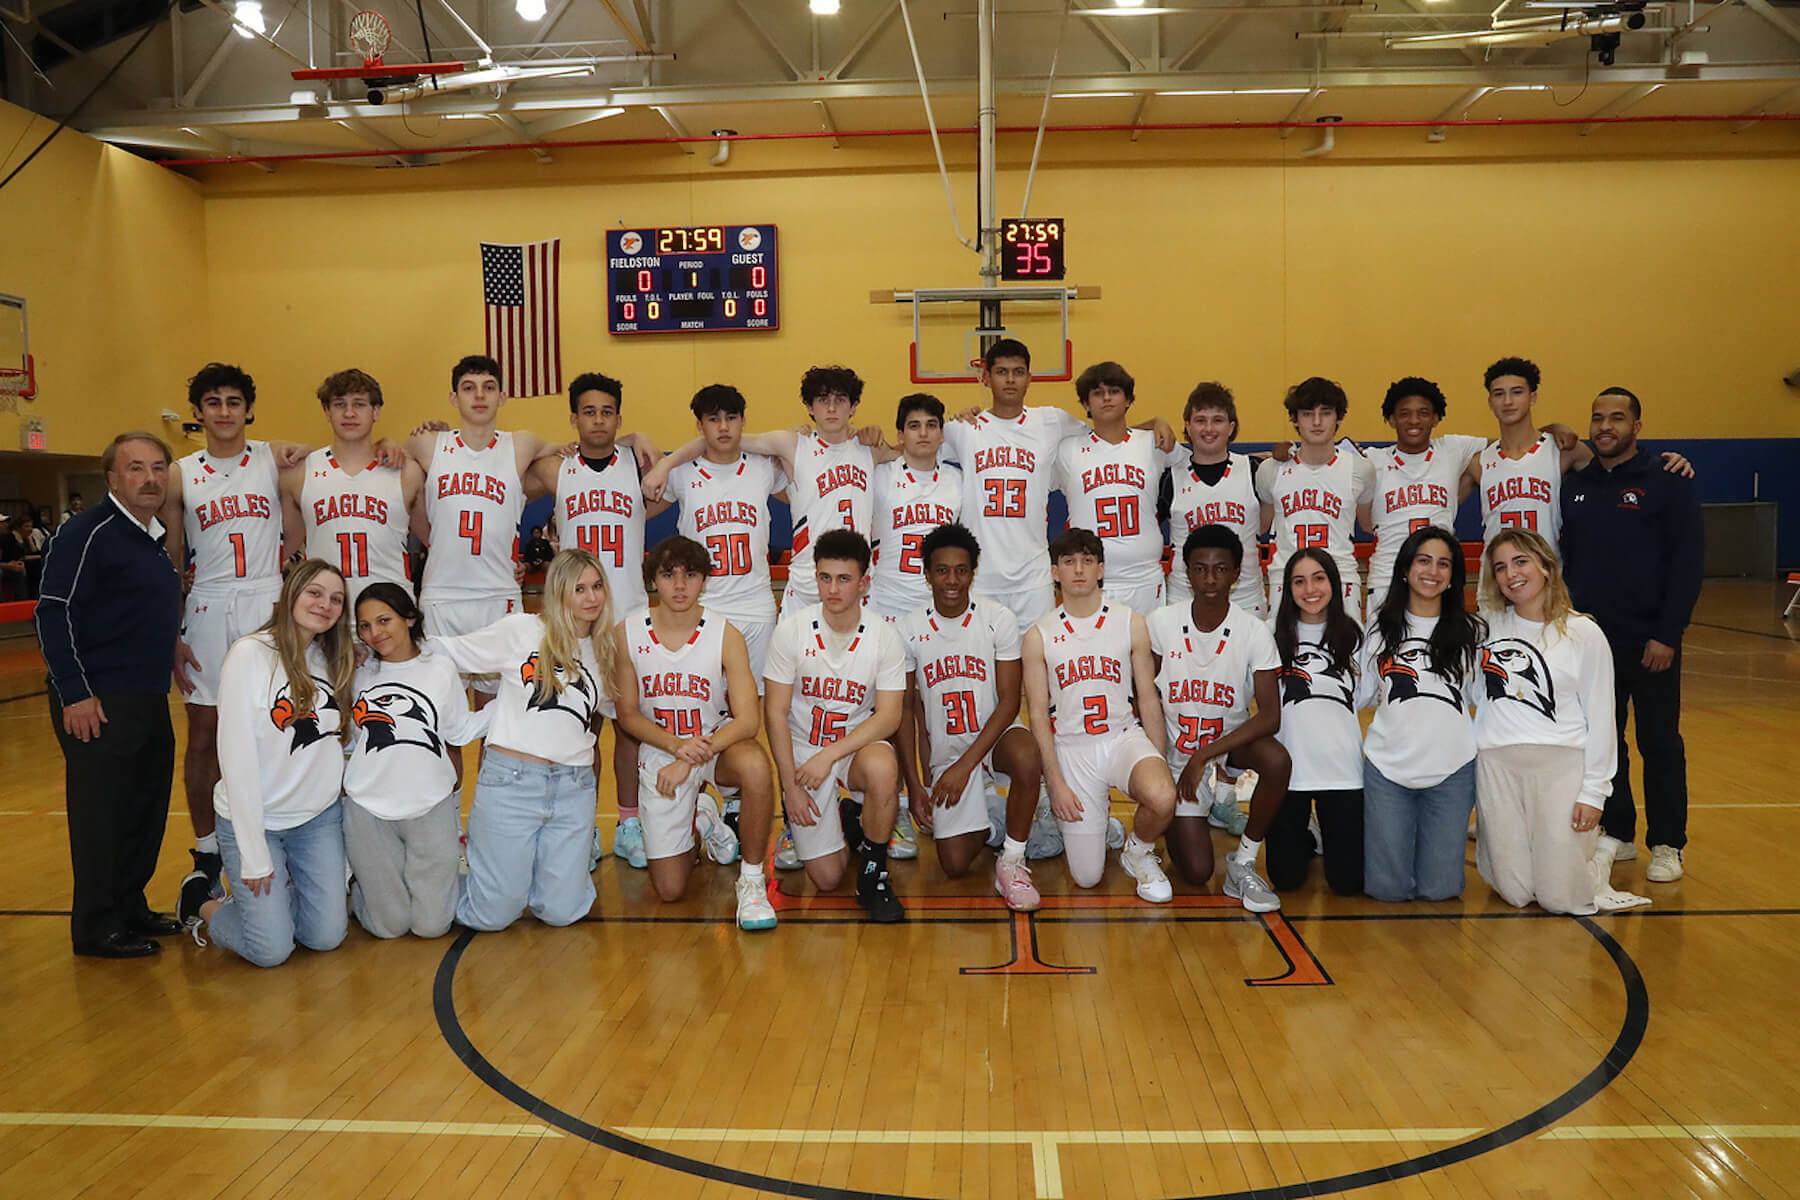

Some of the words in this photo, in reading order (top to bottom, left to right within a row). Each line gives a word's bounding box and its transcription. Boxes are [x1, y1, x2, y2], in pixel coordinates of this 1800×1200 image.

[659, 228, 721, 252] 27:59
[1006, 223, 1059, 242] 27:59
[610, 256, 661, 269] FIELDSTON
[679, 260, 704, 269] PERIOD
[731, 253, 765, 265] GUEST
[1016, 242, 1052, 274] 35
[638, 270, 652, 293] 0
[691, 271, 698, 288] 1
[751, 266, 766, 289] 0
[615, 294, 637, 303] FOULS
[669, 292, 694, 301] PLAYER
[697, 292, 715, 300] FOUL
[724, 299, 736, 318] 0
[746, 290, 769, 299] FOULS
[754, 298, 766, 317] 0
[623, 302, 636, 320] 0
[648, 301, 660, 320] 0
[681, 321, 704, 329] MATCH
[746, 318, 769, 327] SCORE
[616, 322, 638, 331] SCORE
[975, 447, 1036, 474] EAGLES
[438, 473, 506, 505] EAGLES
[816, 464, 868, 498] EAGLES
[1081, 464, 1145, 494] EAGLES
[1487, 477, 1551, 511] EAGLES
[195, 494, 270, 531] EAGLES
[313, 494, 388, 526] EAGLES
[565, 489, 633, 520] EAGLES
[984, 479, 1027, 518] 33
[1280, 489, 1342, 519] EAGLES
[1385, 484, 1448, 514] EAGLES
[694, 501, 757, 533] EAGLES
[838, 499, 855, 531] 3
[893, 504, 954, 530] EAGLES
[1095, 495, 1140, 538] 50
[1185, 502, 1246, 533] EAGLES
[459, 510, 483, 555] 4
[576, 525, 624, 568] 44
[229, 532, 246, 578] 1
[336, 532, 369, 578] 11
[706, 533, 753, 576] 30
[900, 534, 925, 575] 2
[642, 672, 711, 702] EAGLES
[923, 655, 986, 689] EAGLES
[1055, 655, 1121, 690] EAGLES
[801, 676, 866, 706] EAGLES
[1168, 679, 1236, 708] EAGLES
[809, 705, 849, 747] 15
[942, 690, 980, 735] 31
[1083, 694, 1109, 736] 2
[1175, 713, 1224, 755] 22
